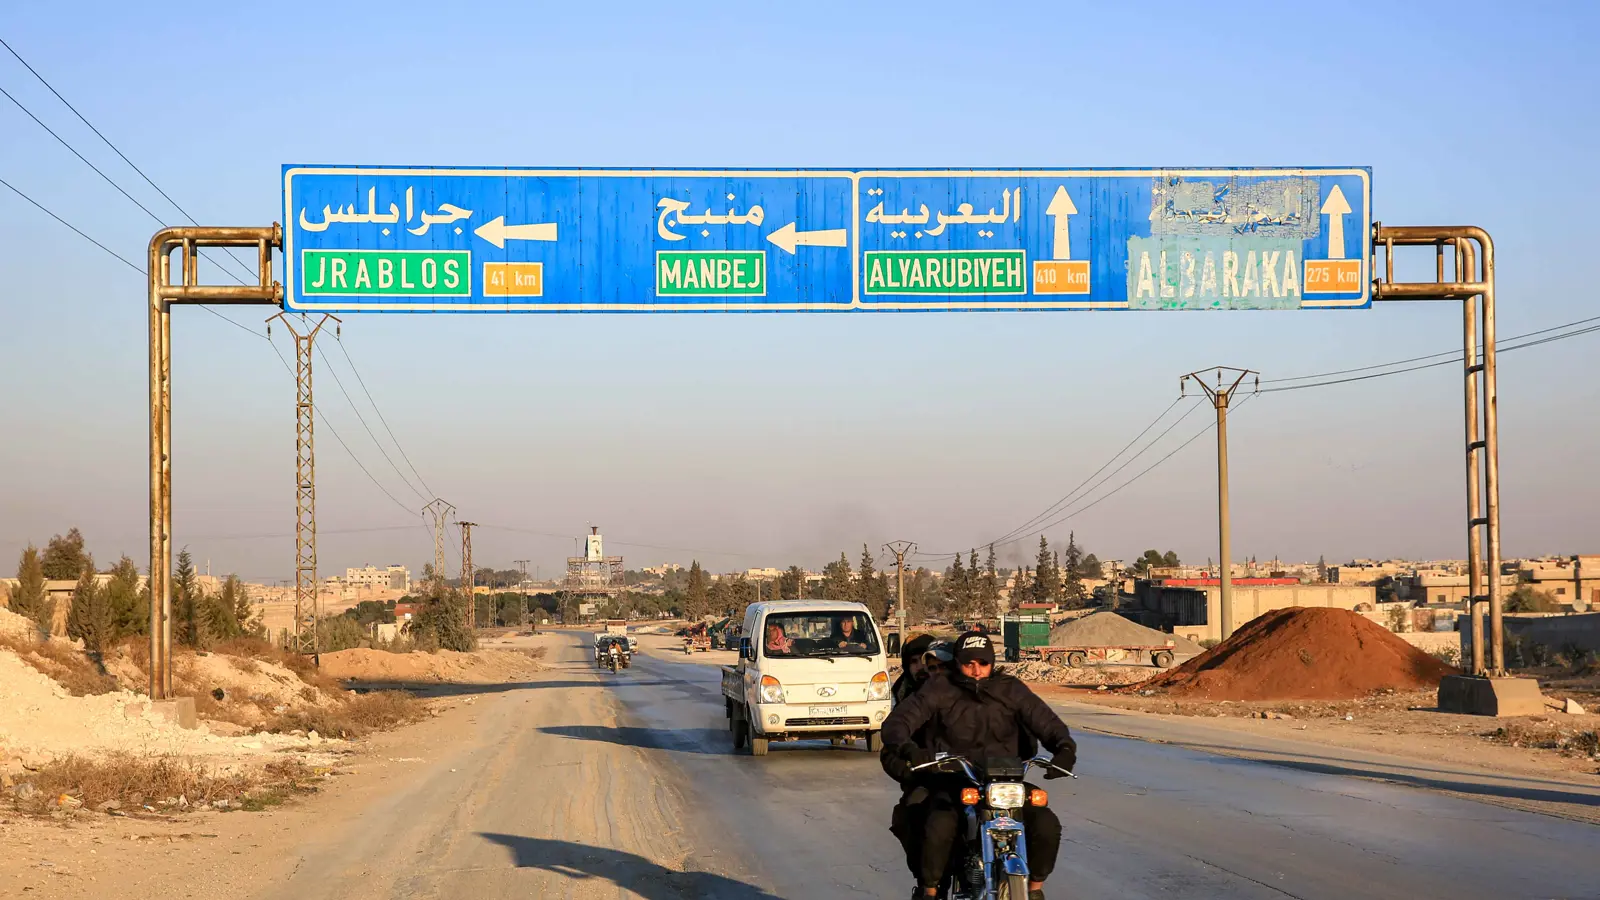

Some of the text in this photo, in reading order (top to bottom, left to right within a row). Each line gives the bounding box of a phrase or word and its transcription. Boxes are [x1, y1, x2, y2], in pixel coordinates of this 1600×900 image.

[299, 186, 473, 237] جرابلس
[657, 192, 764, 241] منبج
[865, 187, 1020, 238] اليعربية
[312, 257, 460, 289] JRABLOS
[491, 268, 536, 288] 41 km
[660, 259, 762, 288] MANBEJ
[869, 258, 1020, 288] ALYARUBIYEH
[1035, 267, 1088, 284] 410 km
[1137, 251, 1300, 297] ALBARAKA
[1307, 265, 1358, 283] 275 km
